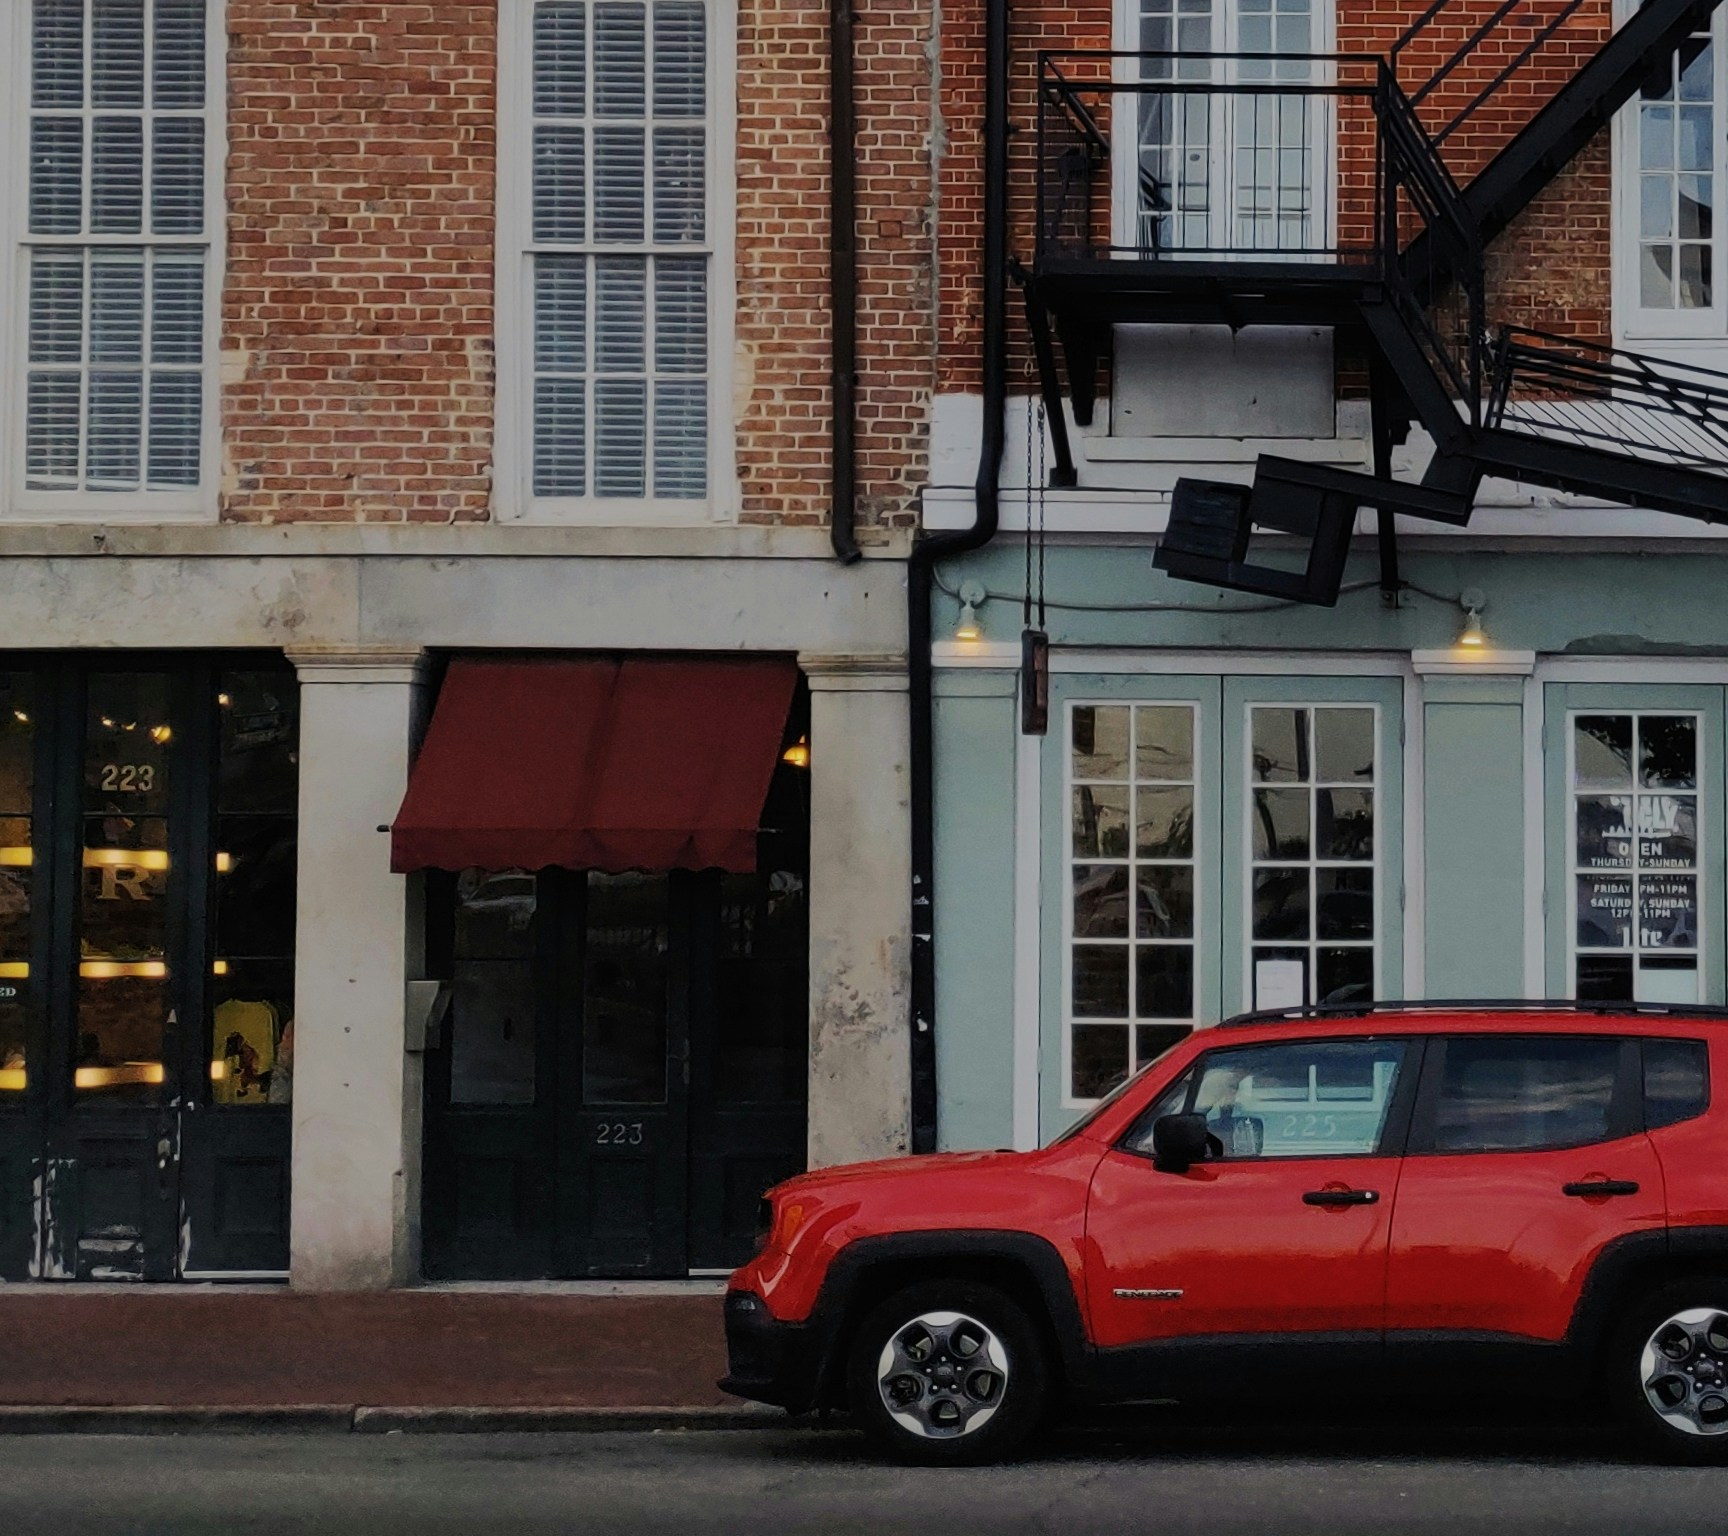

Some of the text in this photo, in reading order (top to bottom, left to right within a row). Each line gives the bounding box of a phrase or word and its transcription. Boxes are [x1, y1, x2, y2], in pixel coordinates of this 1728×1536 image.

[101, 764, 155, 792] 223
[1618, 842, 1663, 856] OEN
[1590, 858, 1691, 868] THURSDY-SUNDAY
[98, 864, 150, 900] R
[1593, 884, 1688, 895] FRIDAY PM-11PM
[1648, 899, 1690, 909] SUNDAY
[1611, 909, 1671, 919] 12P-11PM
[1281, 1113, 1337, 1138] 225
[596, 1123, 643, 1145] 223
